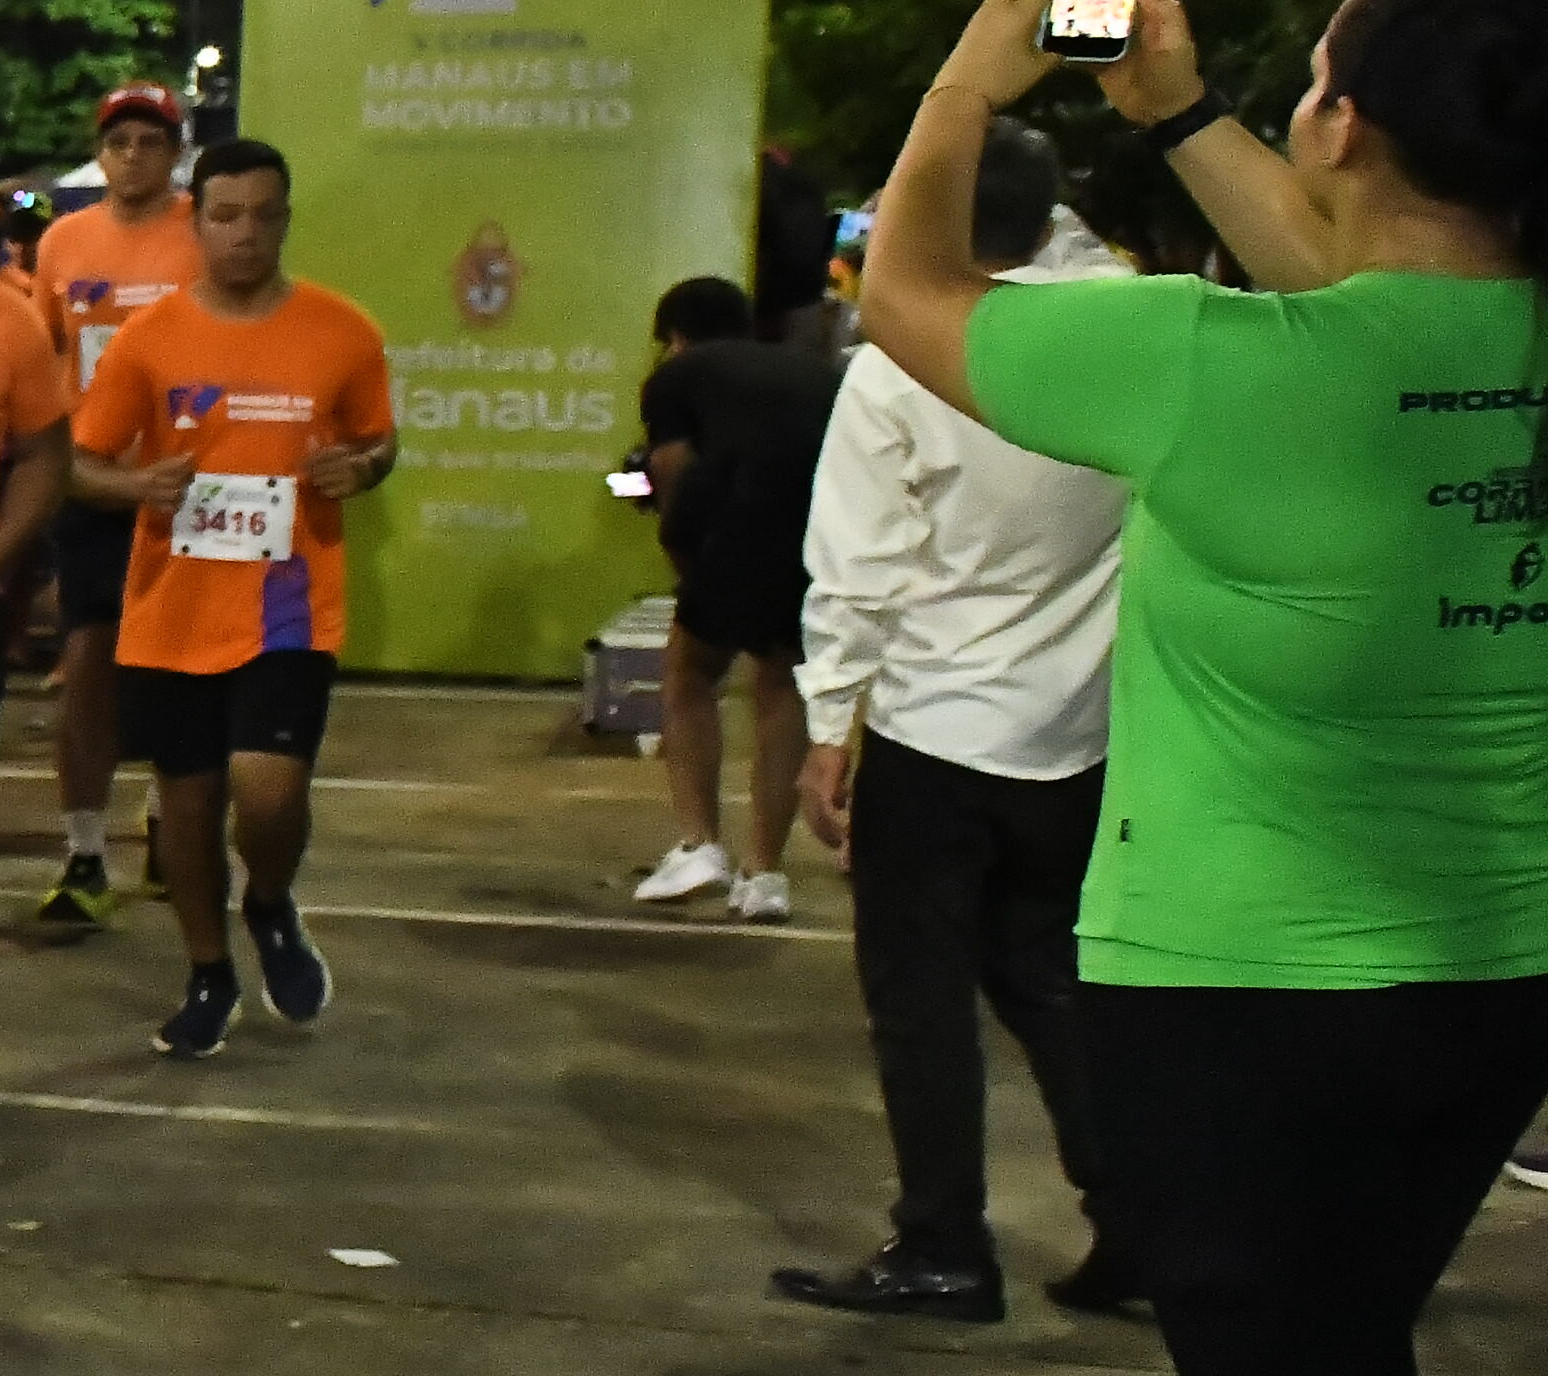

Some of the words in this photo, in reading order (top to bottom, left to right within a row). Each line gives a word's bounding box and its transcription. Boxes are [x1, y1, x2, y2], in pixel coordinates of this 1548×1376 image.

[364, 61, 554, 91] MANAUS
[363, 98, 633, 130] MOVIMENTO
[383, 340, 556, 372] refeitura
[192, 507, 268, 537] 3416
